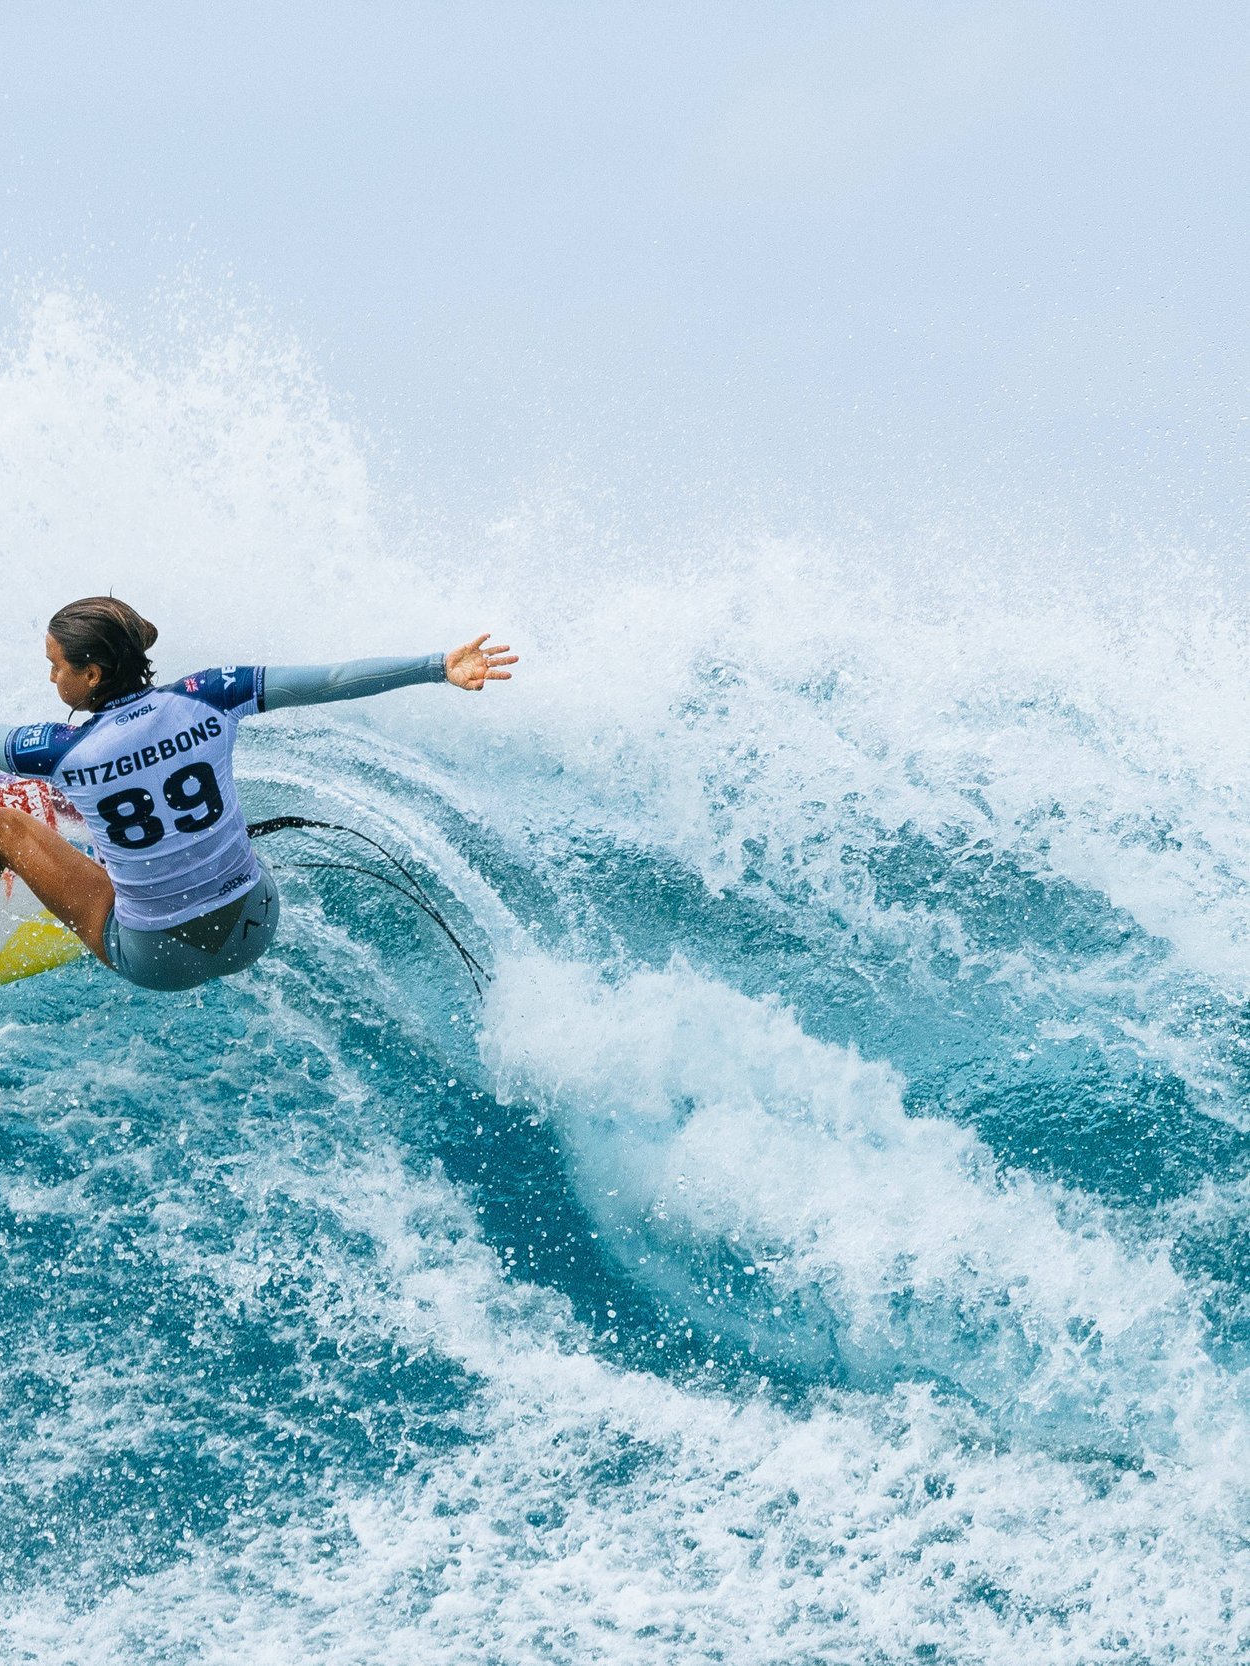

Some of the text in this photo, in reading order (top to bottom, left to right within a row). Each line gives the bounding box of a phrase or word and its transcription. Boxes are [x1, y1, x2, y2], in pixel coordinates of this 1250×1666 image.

[128, 703, 157, 720] WSL
[62, 716, 222, 786] FITZGIBBONS
[97, 761, 224, 849] 89
